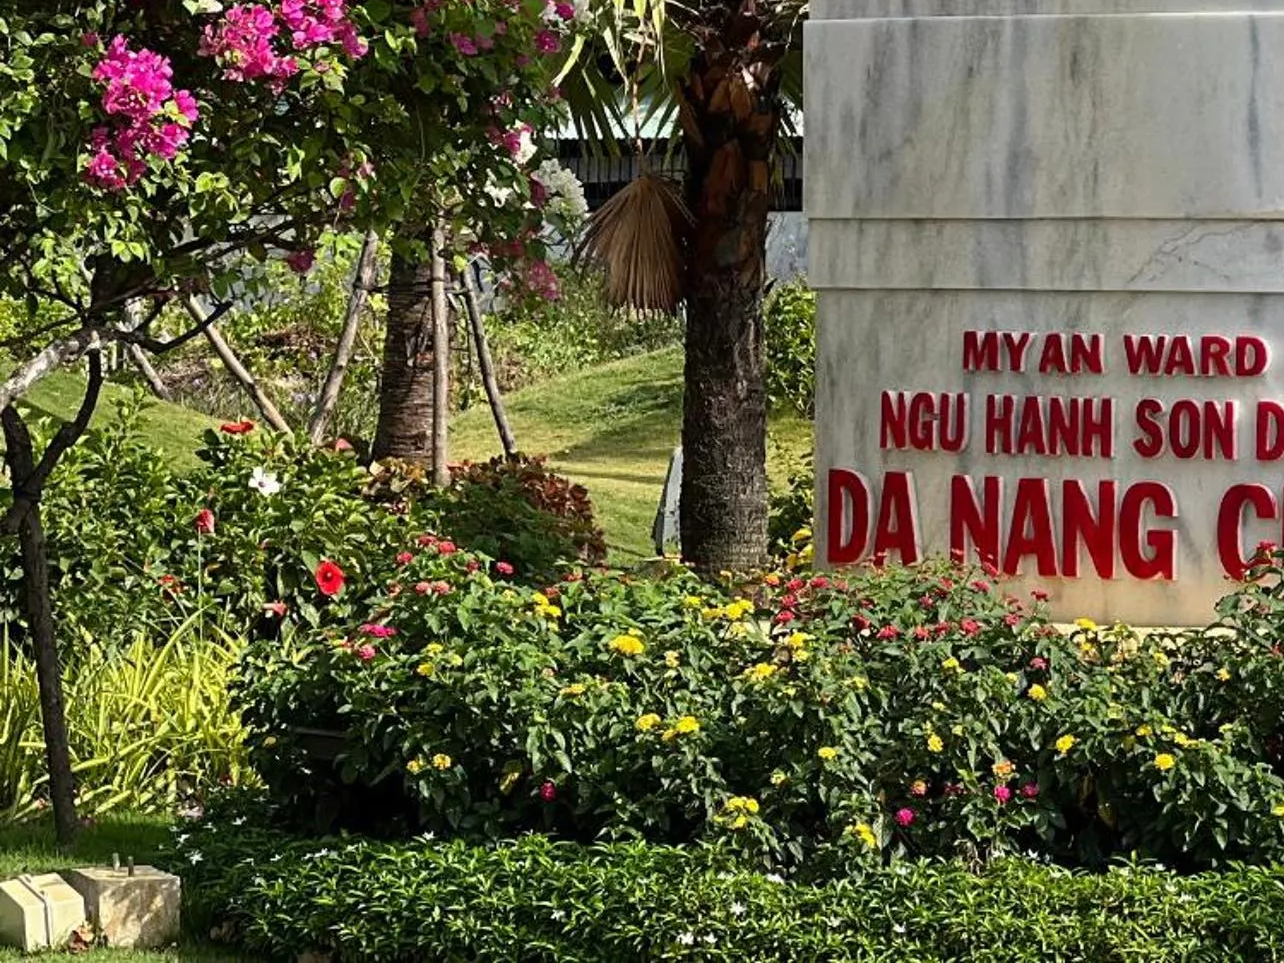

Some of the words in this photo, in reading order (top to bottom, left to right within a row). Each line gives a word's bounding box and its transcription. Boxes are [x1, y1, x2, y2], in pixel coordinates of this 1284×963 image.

[1123, 334, 1270, 377] WARD
[880, 390, 970, 453] NGU
[984, 393, 1115, 459] HANH
[1133, 398, 1238, 461] SON
[827, 467, 921, 567] DA
[949, 475, 1180, 582] NANG
